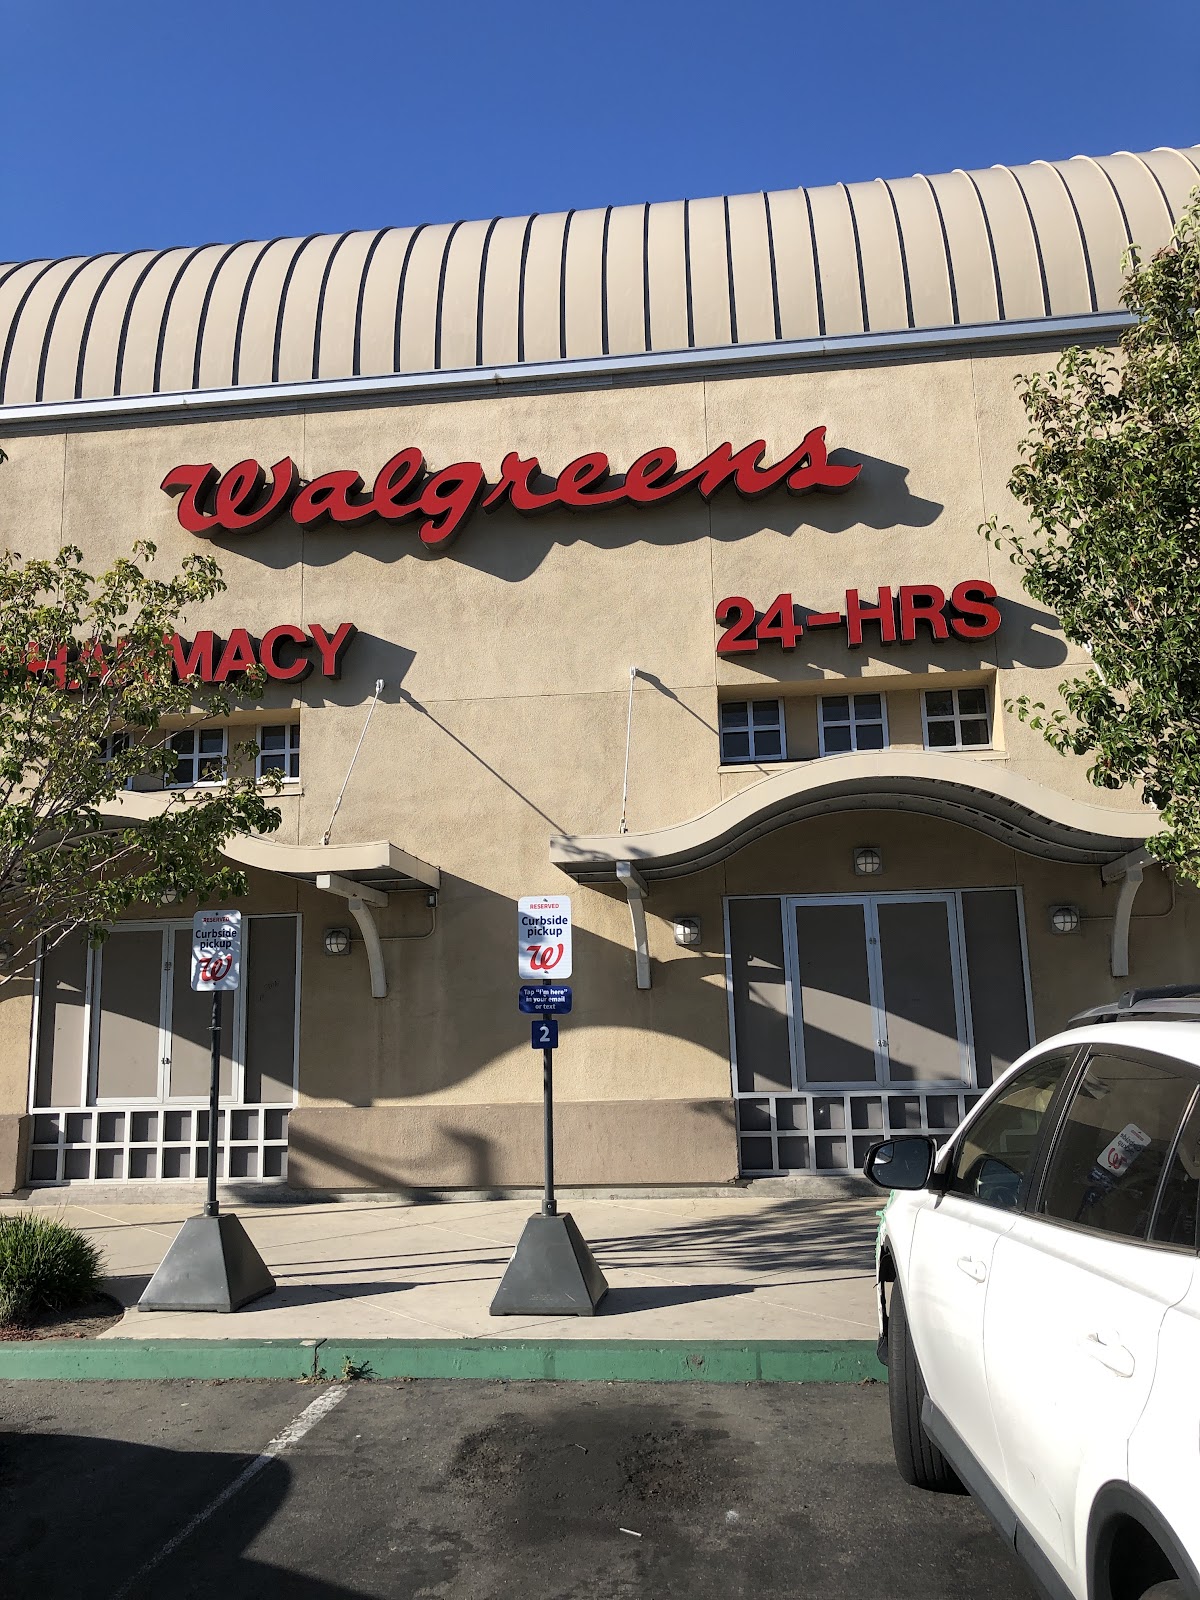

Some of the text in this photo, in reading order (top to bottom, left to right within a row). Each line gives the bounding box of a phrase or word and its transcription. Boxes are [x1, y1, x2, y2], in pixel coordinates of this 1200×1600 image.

[160, 425, 863, 550] Walgreens
[716, 580, 1002, 653] 24-HRS
[521, 915, 568, 926] Curbside
[195, 929, 237, 939] Curbside
[527, 926, 563, 938] pickup
[199, 939, 232, 950] pickup
[526, 943, 565, 971] W
[539, 1026, 551, 1043] 2
